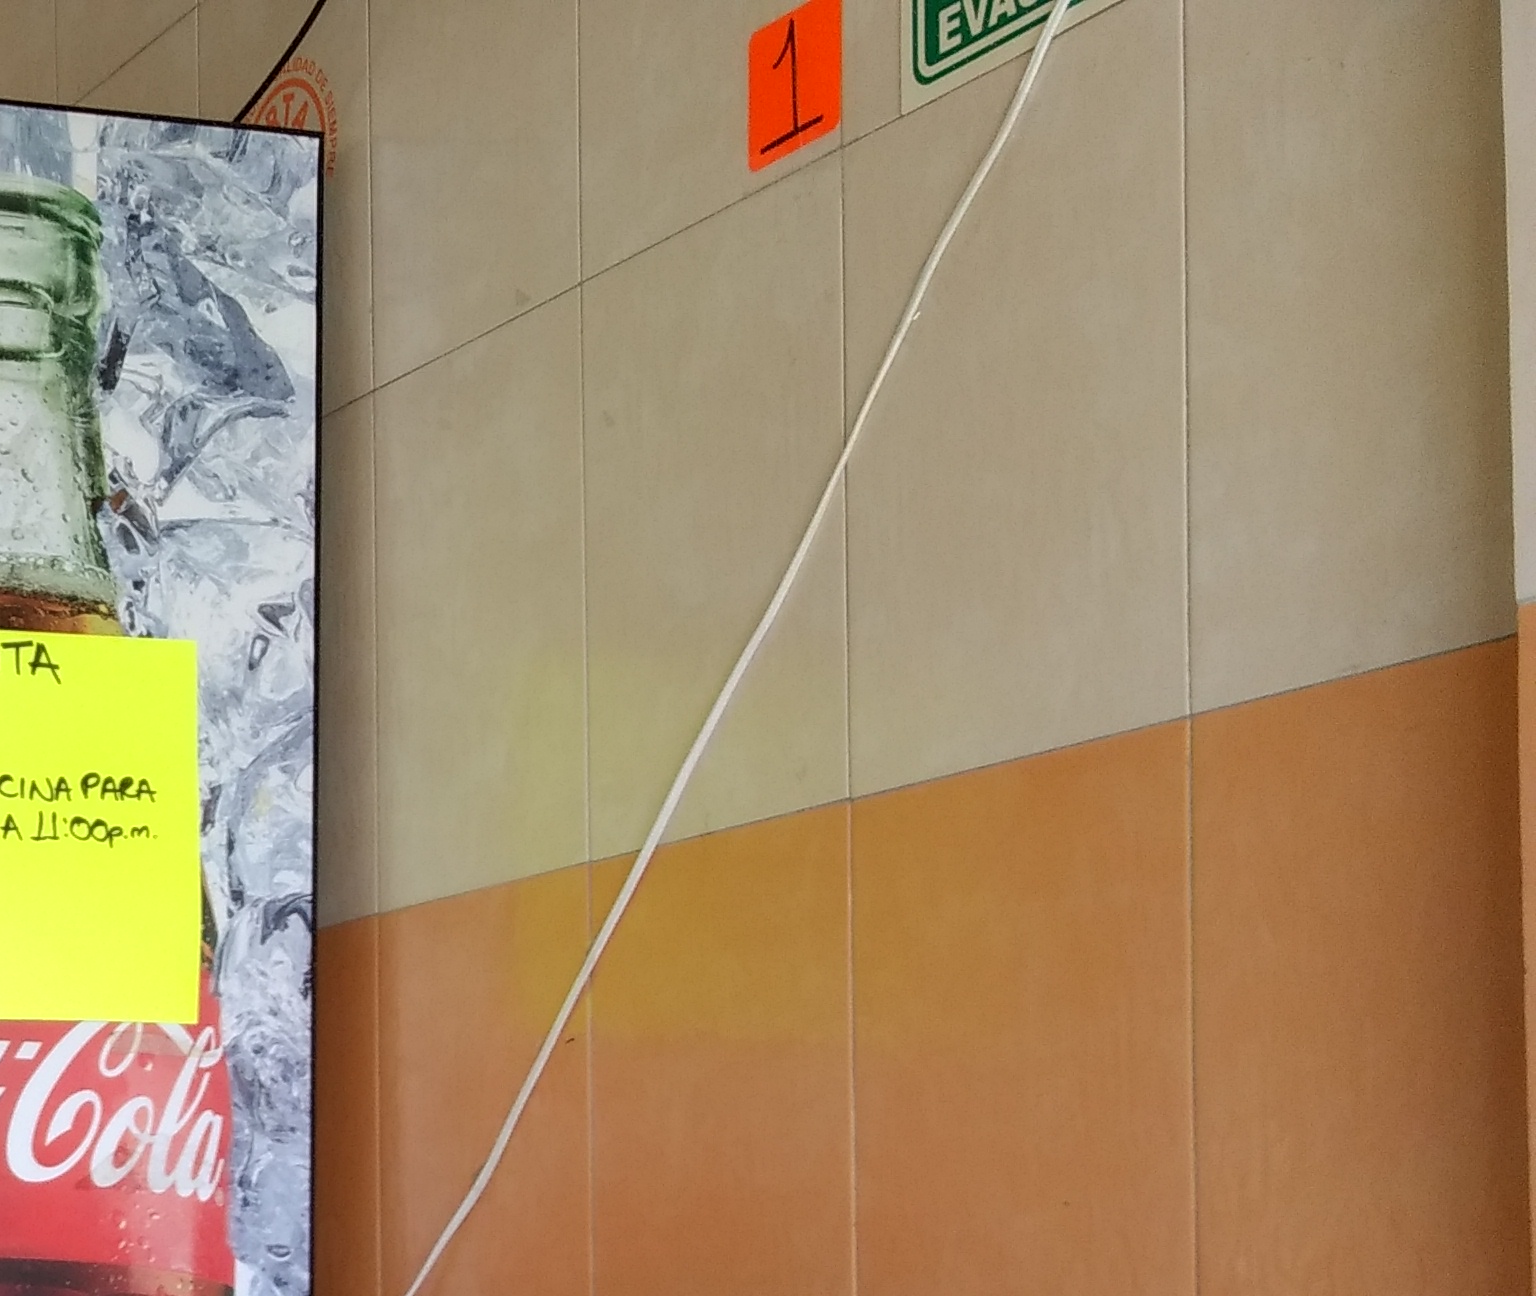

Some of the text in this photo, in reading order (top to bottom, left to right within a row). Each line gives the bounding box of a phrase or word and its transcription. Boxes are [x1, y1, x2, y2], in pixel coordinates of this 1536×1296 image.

[938, 0, 1034, 55] EVA
[80, 772, 157, 802] PARA
[0, 813, 23, 841] A
